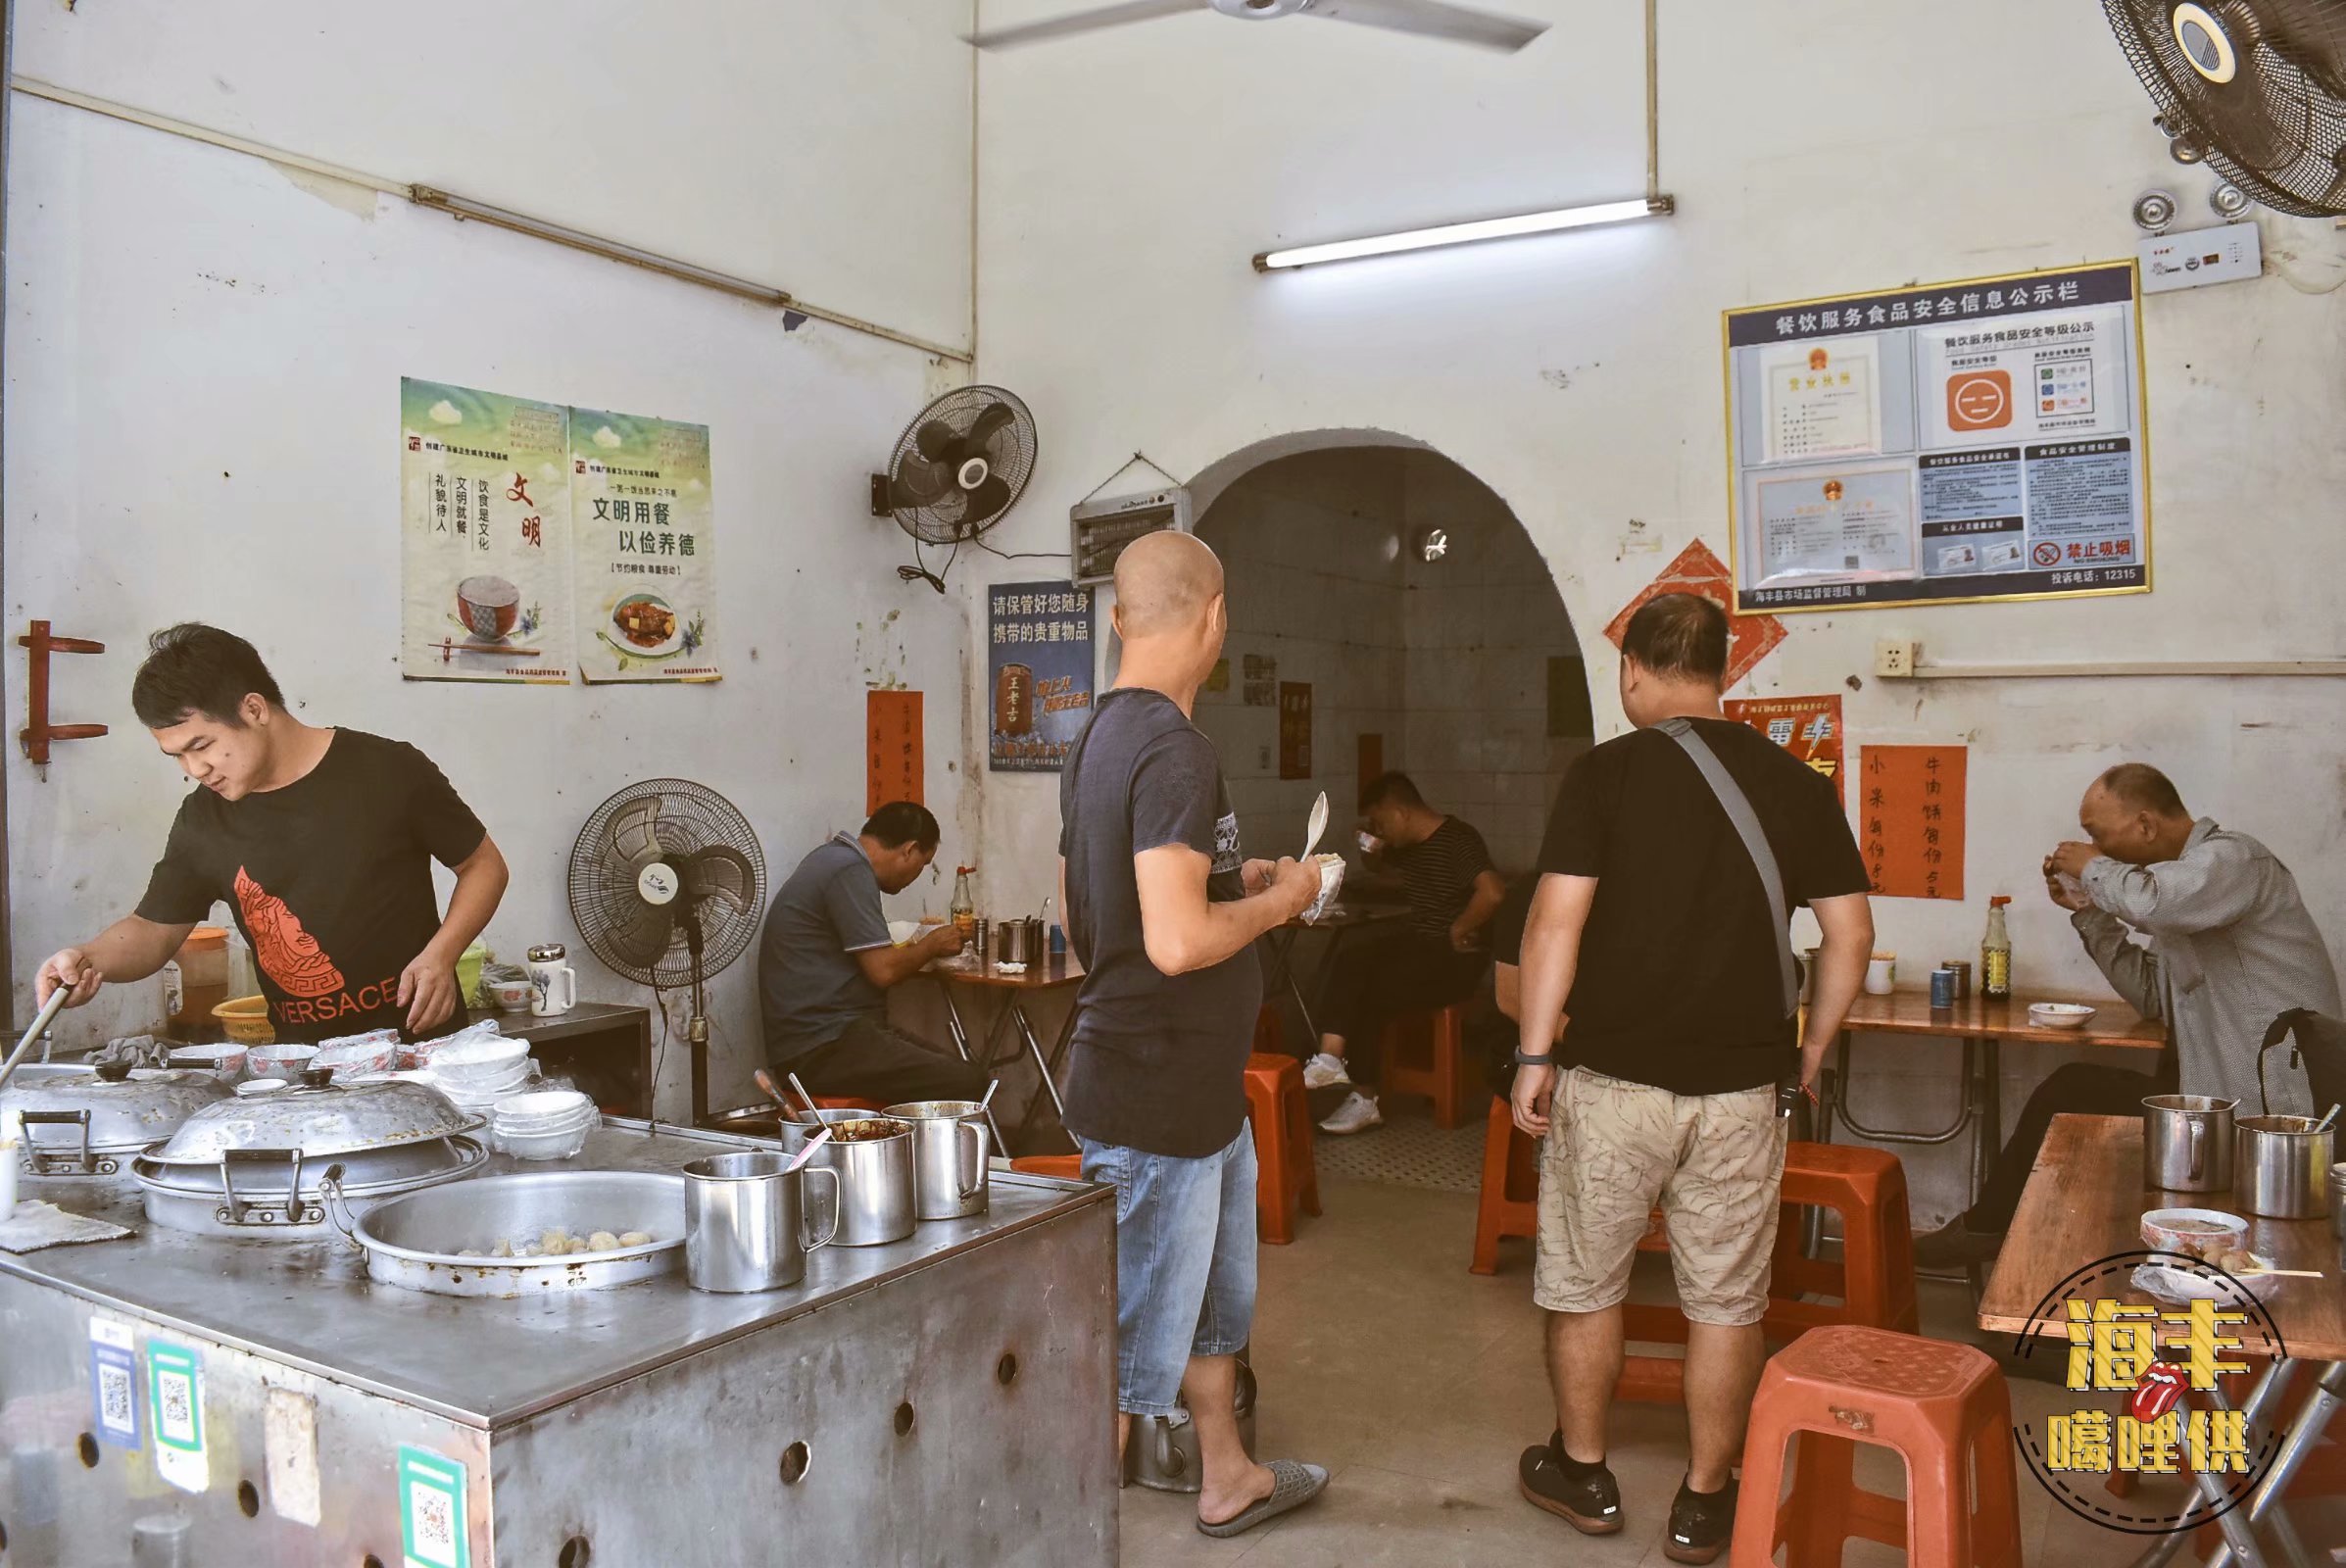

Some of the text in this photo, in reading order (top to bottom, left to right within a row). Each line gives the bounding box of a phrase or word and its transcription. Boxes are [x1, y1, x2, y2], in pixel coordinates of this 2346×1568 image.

[1776, 281, 2079, 335] 餐饮服务食品安全信息公示栏
[1945, 321, 2095, 348] 餐饮服务食品安全等级公示
[435, 473, 447, 532] 礼貌待人
[478, 479, 490, 551] 饮食是文化
[506, 471, 541, 548] 文明
[593, 497, 669, 525] 文明用餐
[619, 530, 695, 557] 以俭养德
[2066, 540, 2130, 559] 禁止吸烟
[2105, 568, 2136, 580] 12315
[993, 593, 1090, 615] 请保管好您随身
[1755, 586, 1851, 603] 海丰县市场监督管理局
[993, 620, 1089, 644] 携带的贵重物品
[1006, 676, 1019, 722] 王老吉
[273, 976, 398, 1025] VERSACE
